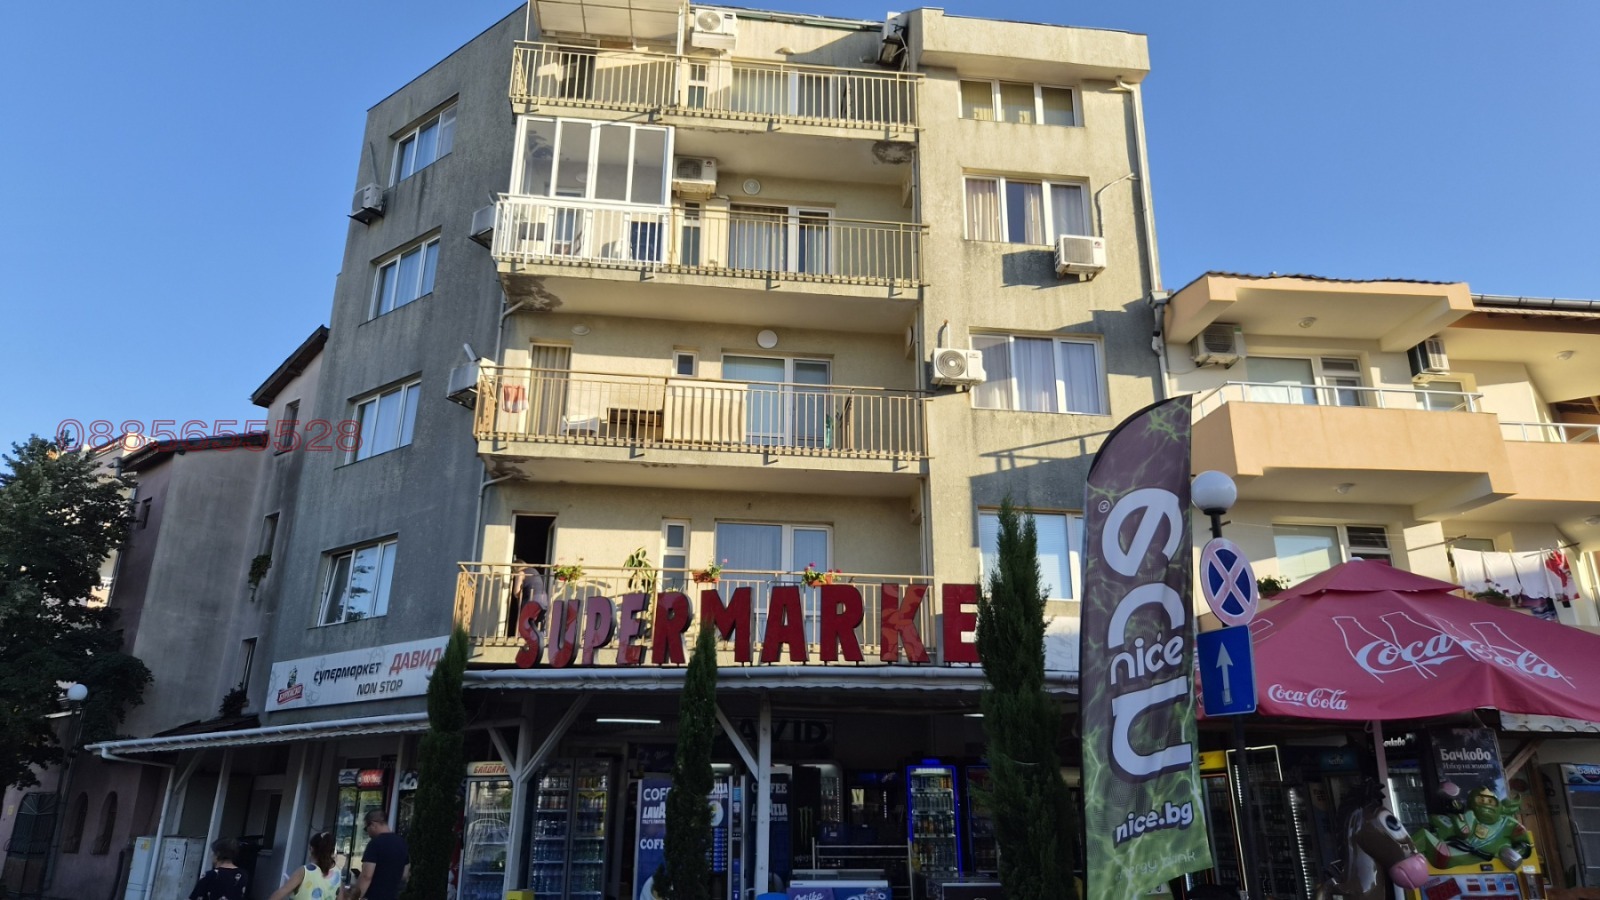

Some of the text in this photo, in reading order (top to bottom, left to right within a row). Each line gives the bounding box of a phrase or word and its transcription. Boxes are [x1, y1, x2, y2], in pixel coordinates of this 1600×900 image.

[388, 647, 442, 675] ДАВИД
[356, 679, 404, 696] NON STOP
[1267, 684, 1349, 711] Coca-Cola
[1440, 747, 1491, 761] Бачково
[751, 782, 788, 794] CFEE
[1116, 801, 1194, 843] nice.bg
